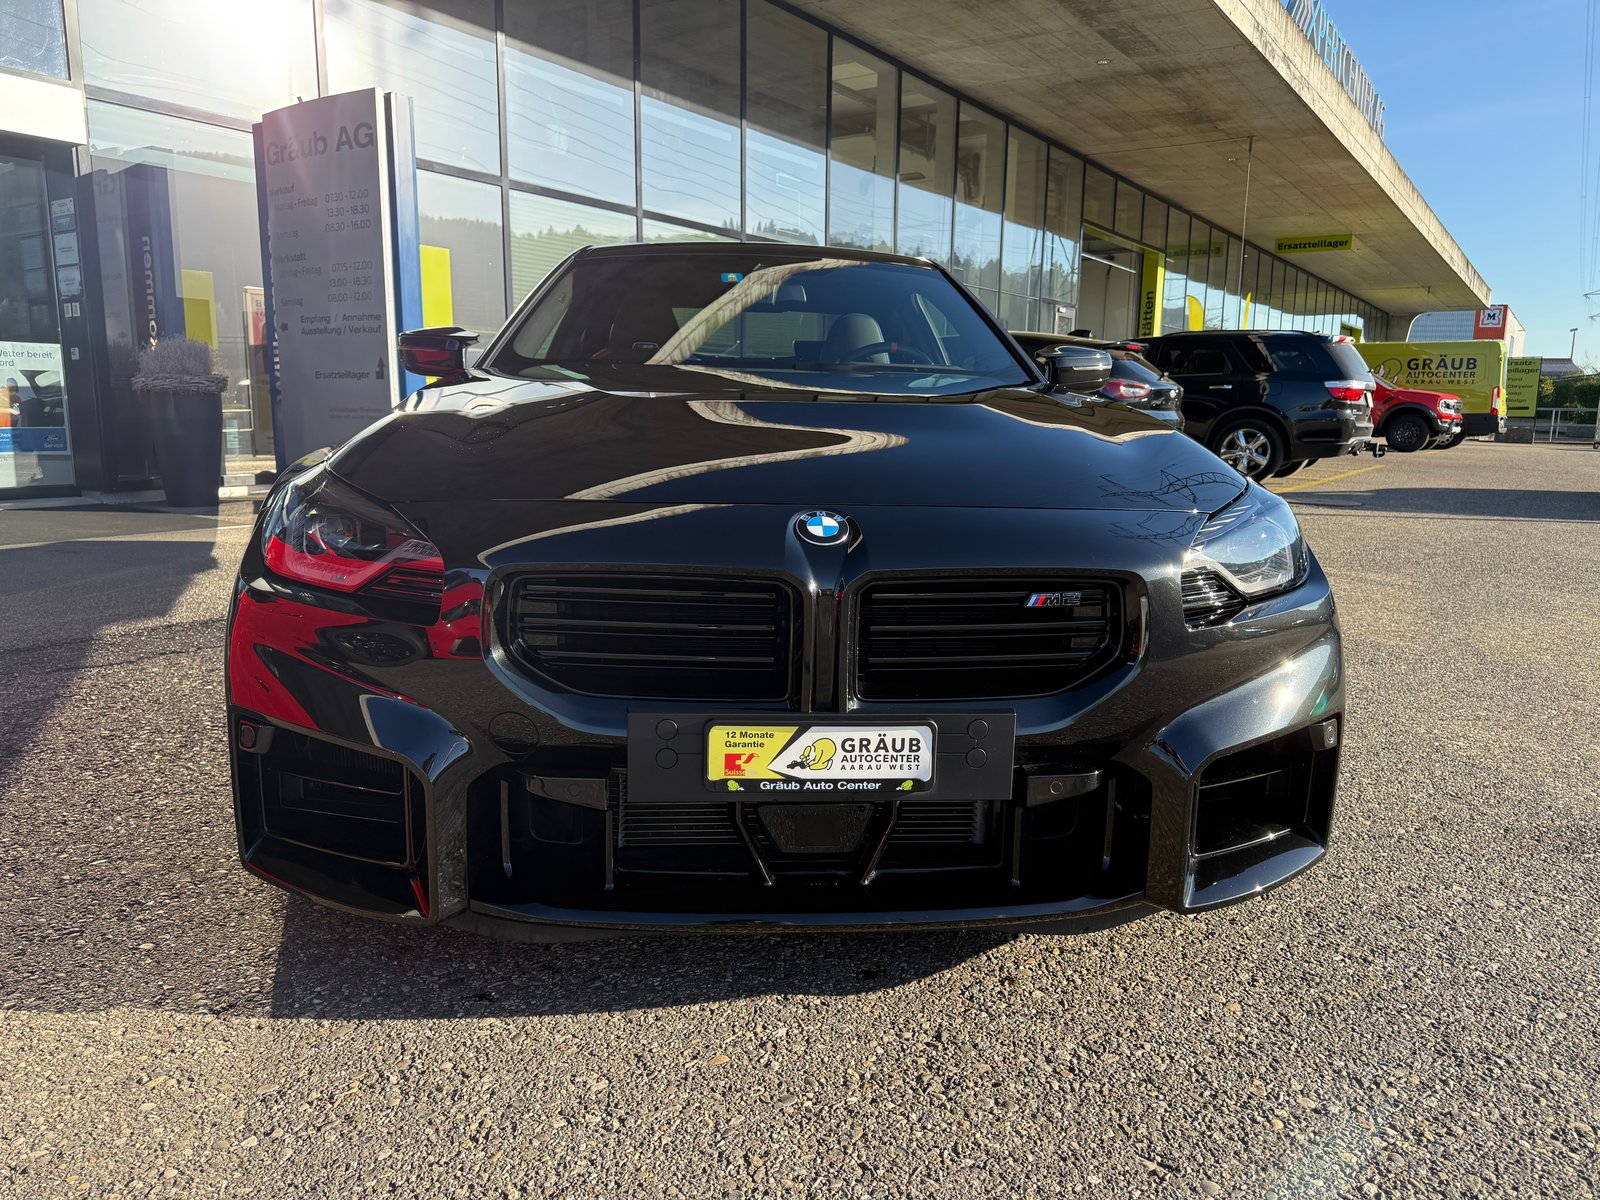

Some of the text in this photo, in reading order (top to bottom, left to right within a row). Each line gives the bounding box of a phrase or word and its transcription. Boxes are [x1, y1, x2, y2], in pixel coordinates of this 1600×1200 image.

[266, 121, 375, 167] Gräub AG
[349, 188, 369, 200] 12.00
[350, 204, 370, 215] 18.30
[324, 222, 345, 232] 08.30
[351, 219, 371, 230] 16.00
[1277, 238, 1349, 250] Ersatzteillager
[353, 260, 373, 270] 12.00
[353, 291, 373, 301] 12.00
[300, 314, 331, 324] Empfang
[342, 312, 381, 322] Annahme
[301, 327, 342, 336] Ausstellung
[348, 325, 382, 334] Verkauf
[27, 350, 55, 360] bereit,
[1407, 354, 1477, 370] GRÄUB
[315, 371, 370, 380] Ersatzteillager
[1041, 592, 1081, 607] M2
[840, 733, 921, 753] GRÄUB
[840, 754, 920, 763] AUTOCENTER
[760, 781, 881, 790] Gräub Auto Center
